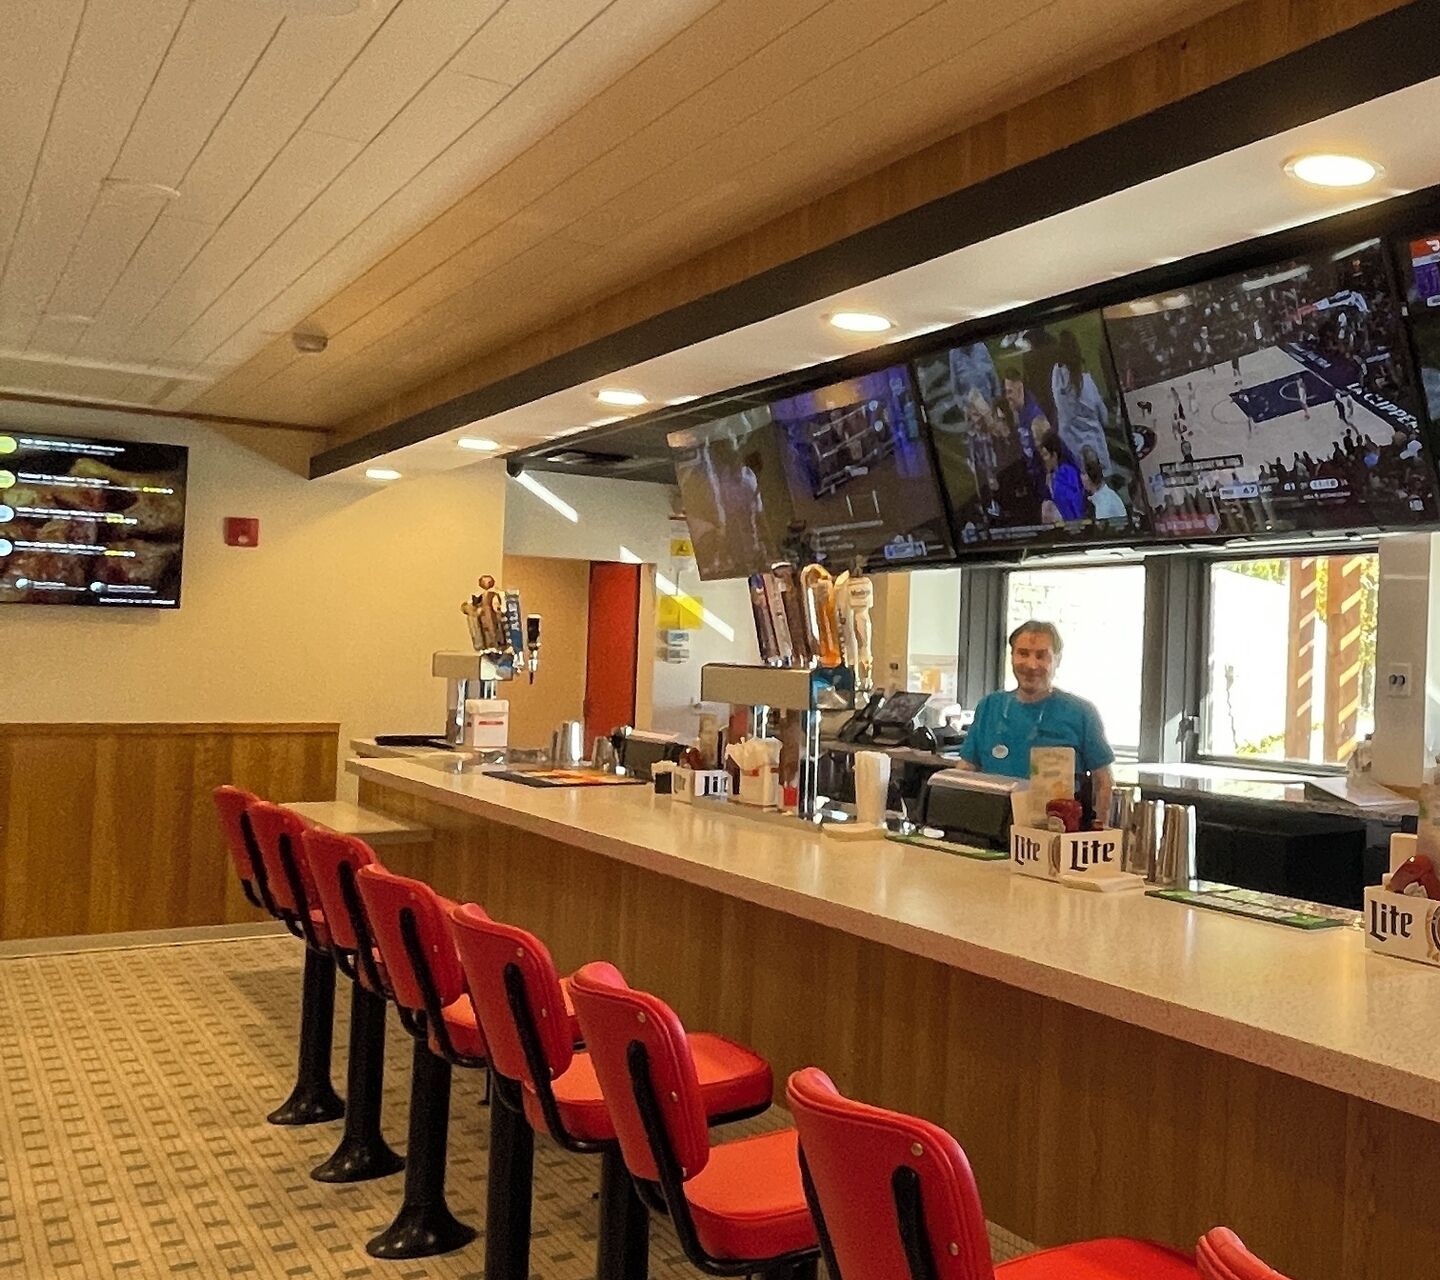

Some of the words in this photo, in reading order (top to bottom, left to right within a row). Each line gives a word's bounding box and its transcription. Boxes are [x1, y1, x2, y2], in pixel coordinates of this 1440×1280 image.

[1014, 834, 1041, 866] Lite
[1070, 839, 1115, 872] Lite
[1369, 899, 1413, 942] Lite
